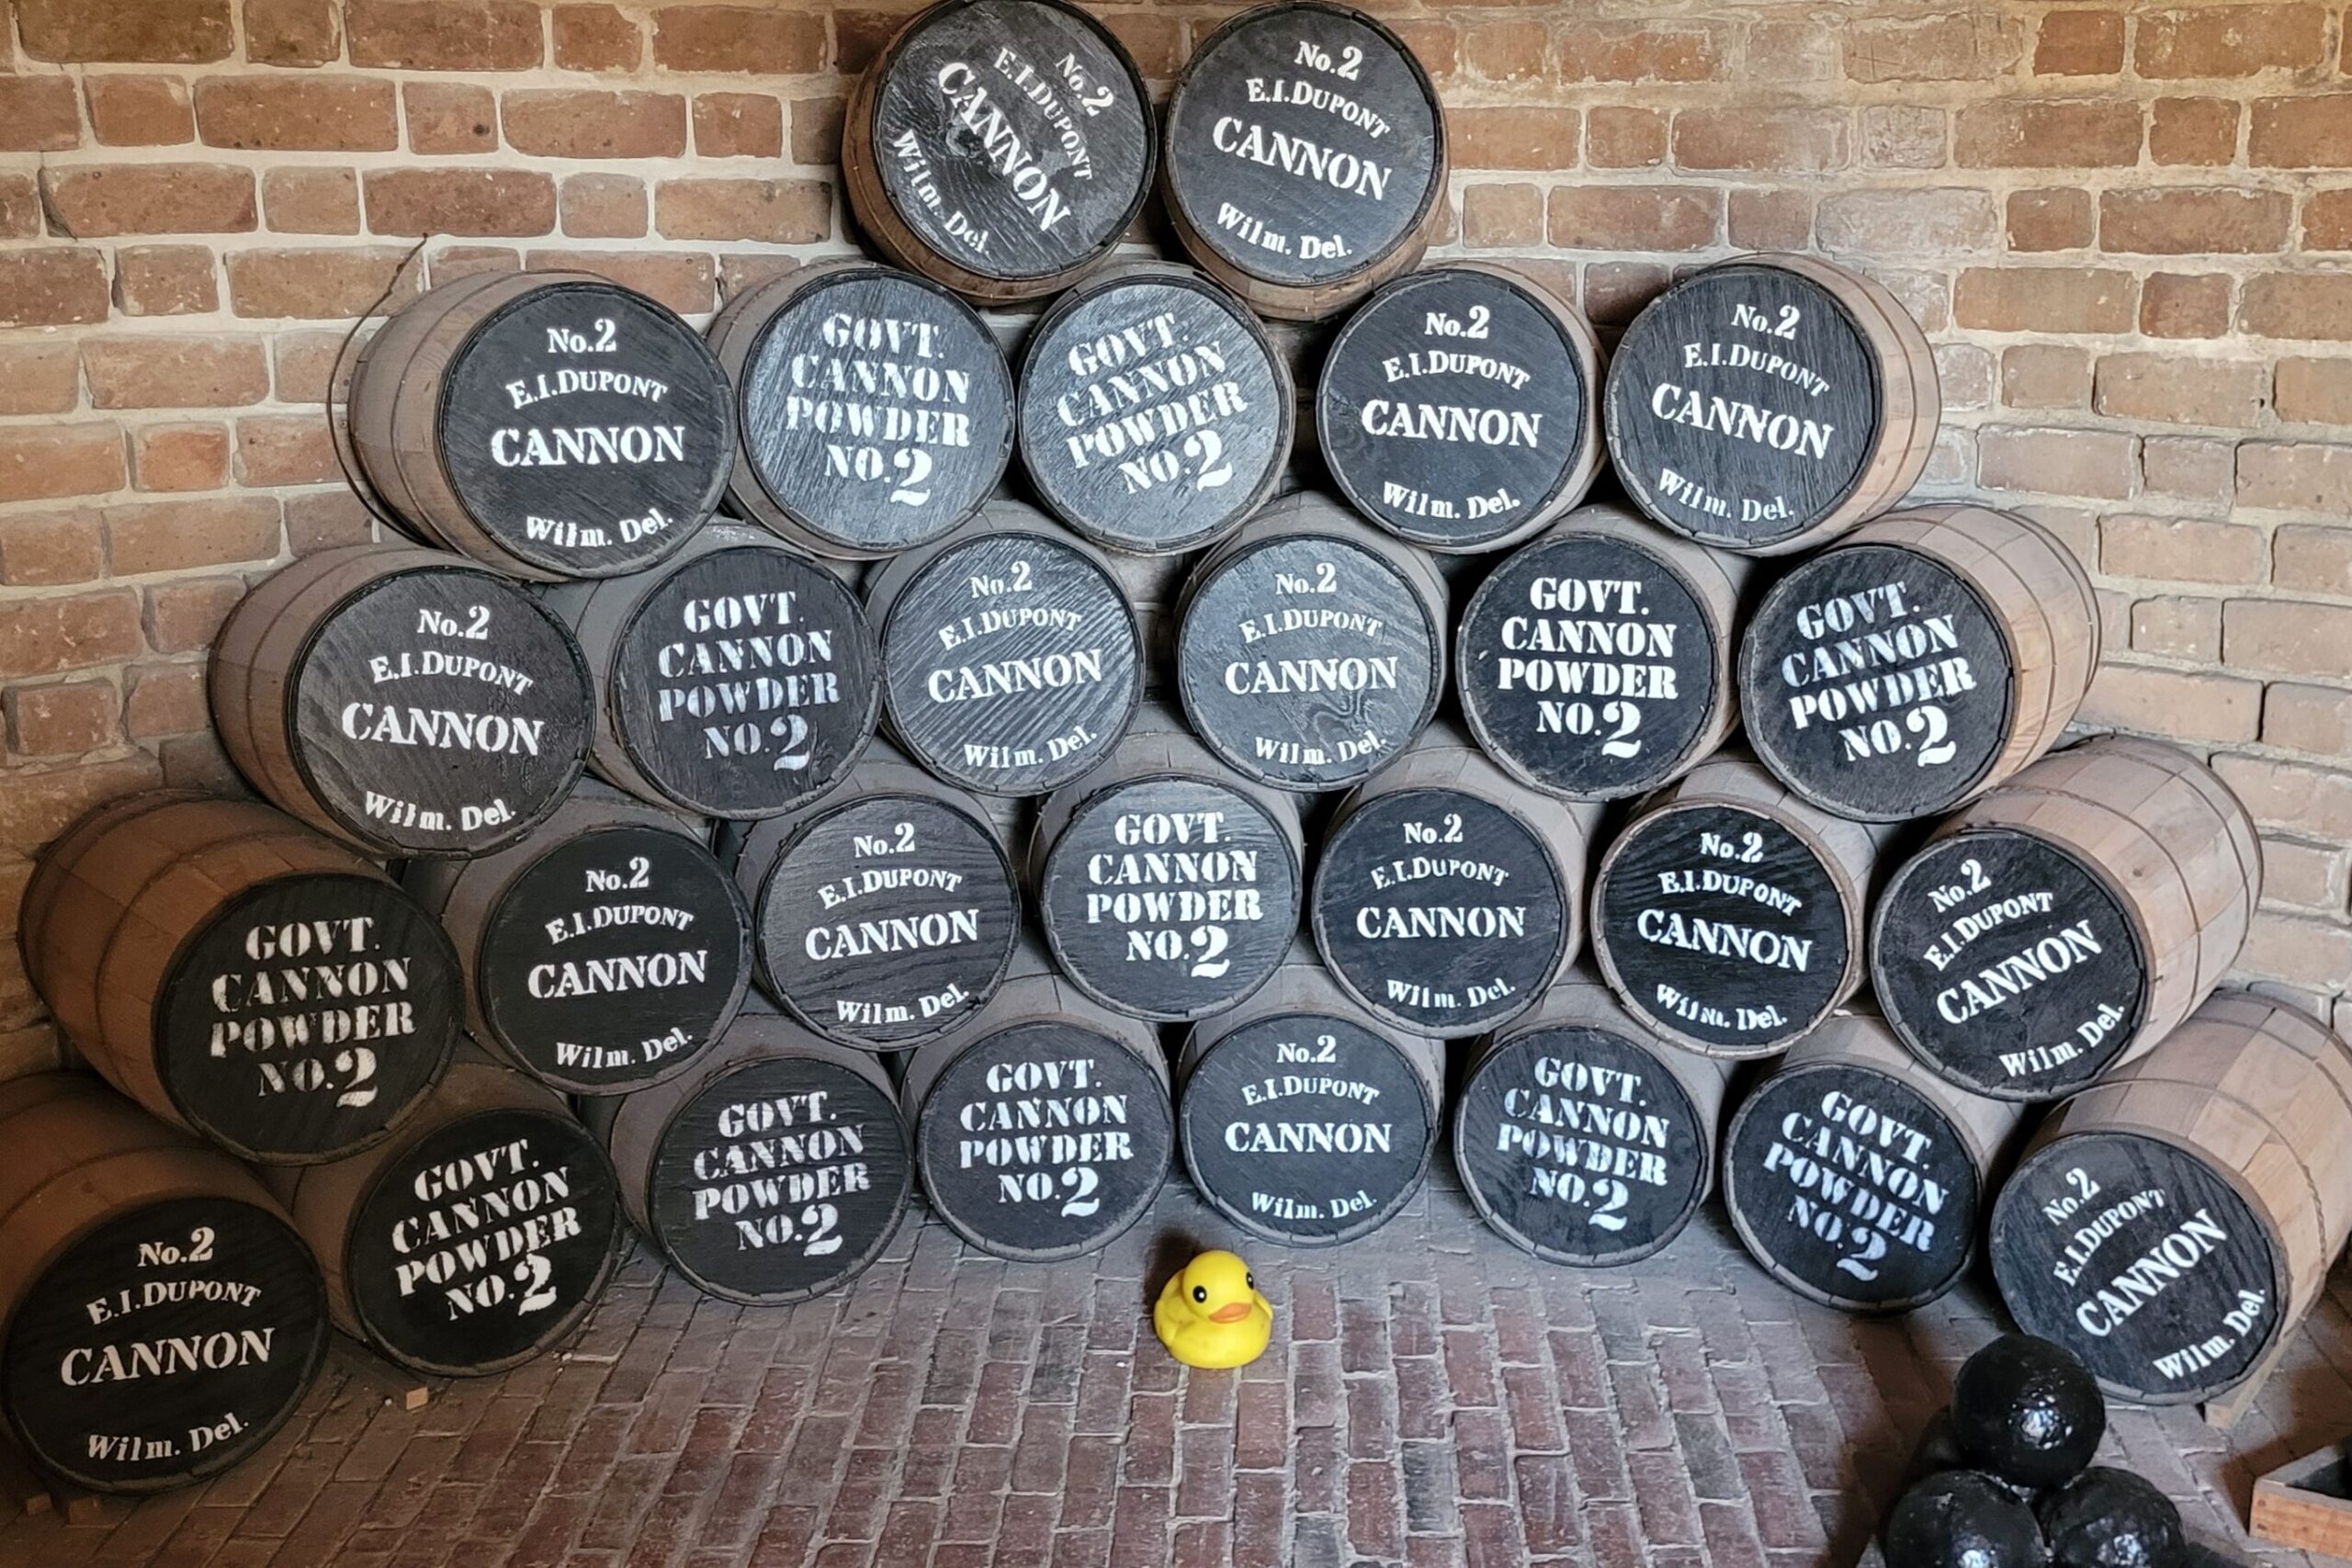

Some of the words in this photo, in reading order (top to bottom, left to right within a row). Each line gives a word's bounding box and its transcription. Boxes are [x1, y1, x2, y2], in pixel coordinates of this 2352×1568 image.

[1295, 41, 1363, 80] No.2
[938, 62, 1070, 233] CANNON
[1213, 117, 1392, 200] CANNON
[893, 130, 943, 219] Wilm.
[1217, 202, 1291, 254] Wilm.
[1299, 234, 1352, 259] Del.
[547, 319, 616, 353] No.2
[823, 313, 944, 358] GOVT.
[1069, 313, 1188, 376] GOVT.
[1425, 306, 1489, 339] No.2
[1731, 304, 1800, 339] No.2
[792, 355, 969, 403] CANNON
[1057, 341, 1227, 426] CANNON
[786, 396, 970, 446] POWDER
[1067, 380, 1249, 468] POWDER
[1362, 400, 1543, 447] CANNON
[1653, 383, 1834, 459] CANNON
[491, 426, 684, 467] CANNON
[1384, 481, 1460, 518] Wilm.
[1466, 489, 1521, 519] Del.
[1659, 468, 1731, 518] Wilm.
[1742, 496, 1794, 521] Del.
[527, 516, 612, 547] Wilm.
[619, 508, 673, 543] Del.
[971, 560, 1033, 598] No.2
[1275, 563, 1337, 594] No.2
[1531, 578, 1648, 615] GOVT.
[417, 605, 490, 639] No.2
[684, 592, 803, 632] GOVT.
[1797, 581, 1919, 639] GOVT.
[659, 630, 831, 677] CANNON
[1502, 616, 1677, 657] CANNON
[1782, 615, 1958, 686] CANNON
[660, 672, 840, 721] POWDER
[928, 647, 1104, 703] CANNON
[1226, 657, 1397, 694] CANNON
[1498, 658, 1678, 699] POWDER
[1790, 658, 1977, 728] POWDER
[342, 703, 544, 755] CANNON
[704, 715, 809, 770] NO.2
[964, 744, 1043, 768] Wilm.
[1047, 725, 1098, 761] Del.
[1256, 737, 1331, 764] Wilm.
[1338, 730, 1386, 761] Del.
[1537, 701, 1641, 758] NO.2
[1839, 705, 1956, 766] NO.2
[366, 791, 451, 830] Wilm.
[461, 799, 515, 830] Del.
[1114, 811, 1232, 845] GOVT.
[1403, 814, 1463, 843] No.2
[854, 823, 915, 857] No.2
[1701, 832, 1763, 863] No.2
[586, 857, 650, 892] No.2
[1089, 851, 1257, 885] CANNON
[1928, 859, 1991, 912] No.2
[1088, 889, 1263, 923] POWDER
[1357, 907, 1526, 938] CANNON
[246, 918, 379, 960] GOVT.
[806, 909, 978, 960] CANNON
[1126, 925, 1230, 978] NO.2
[1638, 909, 1813, 972] CANNON
[213, 958, 410, 1012] CANNON
[528, 950, 707, 998] CANNON
[1387, 980, 1462, 1008] Wilm.
[1467, 978, 1515, 1007] Del.
[1937, 919, 2101, 1023] CANNON
[837, 1000, 914, 1023] Wilm.
[919, 984, 968, 1017] Del.
[1657, 984, 1730, 1028] Wilm.
[1736, 1005, 1787, 1030] Del.
[211, 1002, 415, 1056] POWDER
[557, 1043, 635, 1068] Wilm.
[642, 1028, 692, 1062] Del.
[1277, 1035, 1336, 1063] No.2
[1999, 1042, 2083, 1077] Wilm.
[2077, 1004, 2124, 1047] Del.
[259, 1048, 378, 1107] NO.2
[987, 1059, 1101, 1092] GOVT.
[1535, 1057, 1645, 1106] GOVT.
[718, 1091, 836, 1137] GOVT.
[961, 1095, 1126, 1131] CANNON
[1226, 1122, 1392, 1153] CANNON
[1505, 1089, 1669, 1148] CANNON
[1822, 1091, 1931, 1169] GOVT.
[415, 1139, 538, 1201] GOVT.
[695, 1124, 863, 1179] CANNON
[960, 1132, 1134, 1168] POWDER
[1497, 1123, 1667, 1186] POWDER
[1782, 1112, 1949, 1213] CANNON
[392, 1167, 569, 1253] CANNON
[693, 1163, 870, 1220] POWDER
[999, 1168, 1100, 1216] NO.2
[1250, 1192, 1324, 1220] Wilm.
[1330, 1190, 1376, 1217] Del.
[1531, 1168, 1628, 1231] NO.2
[1764, 1143, 1934, 1251] POWDER
[2042, 1168, 2100, 1225] No.2
[138, 1227, 214, 1267] No.2
[396, 1207, 581, 1295] POWDER
[736, 1204, 842, 1256] NO.2
[1788, 1196, 1885, 1282] NO.2
[446, 1253, 556, 1320] NO.2
[2076, 1209, 2226, 1336] CANNON
[62, 1328, 275, 1385] CANNON
[2153, 1336, 2234, 1379] Wilm.
[2223, 1290, 2265, 1337] Del.
[89, 1435, 180, 1461] Wilm.
[189, 1413, 248, 1451] Del.
